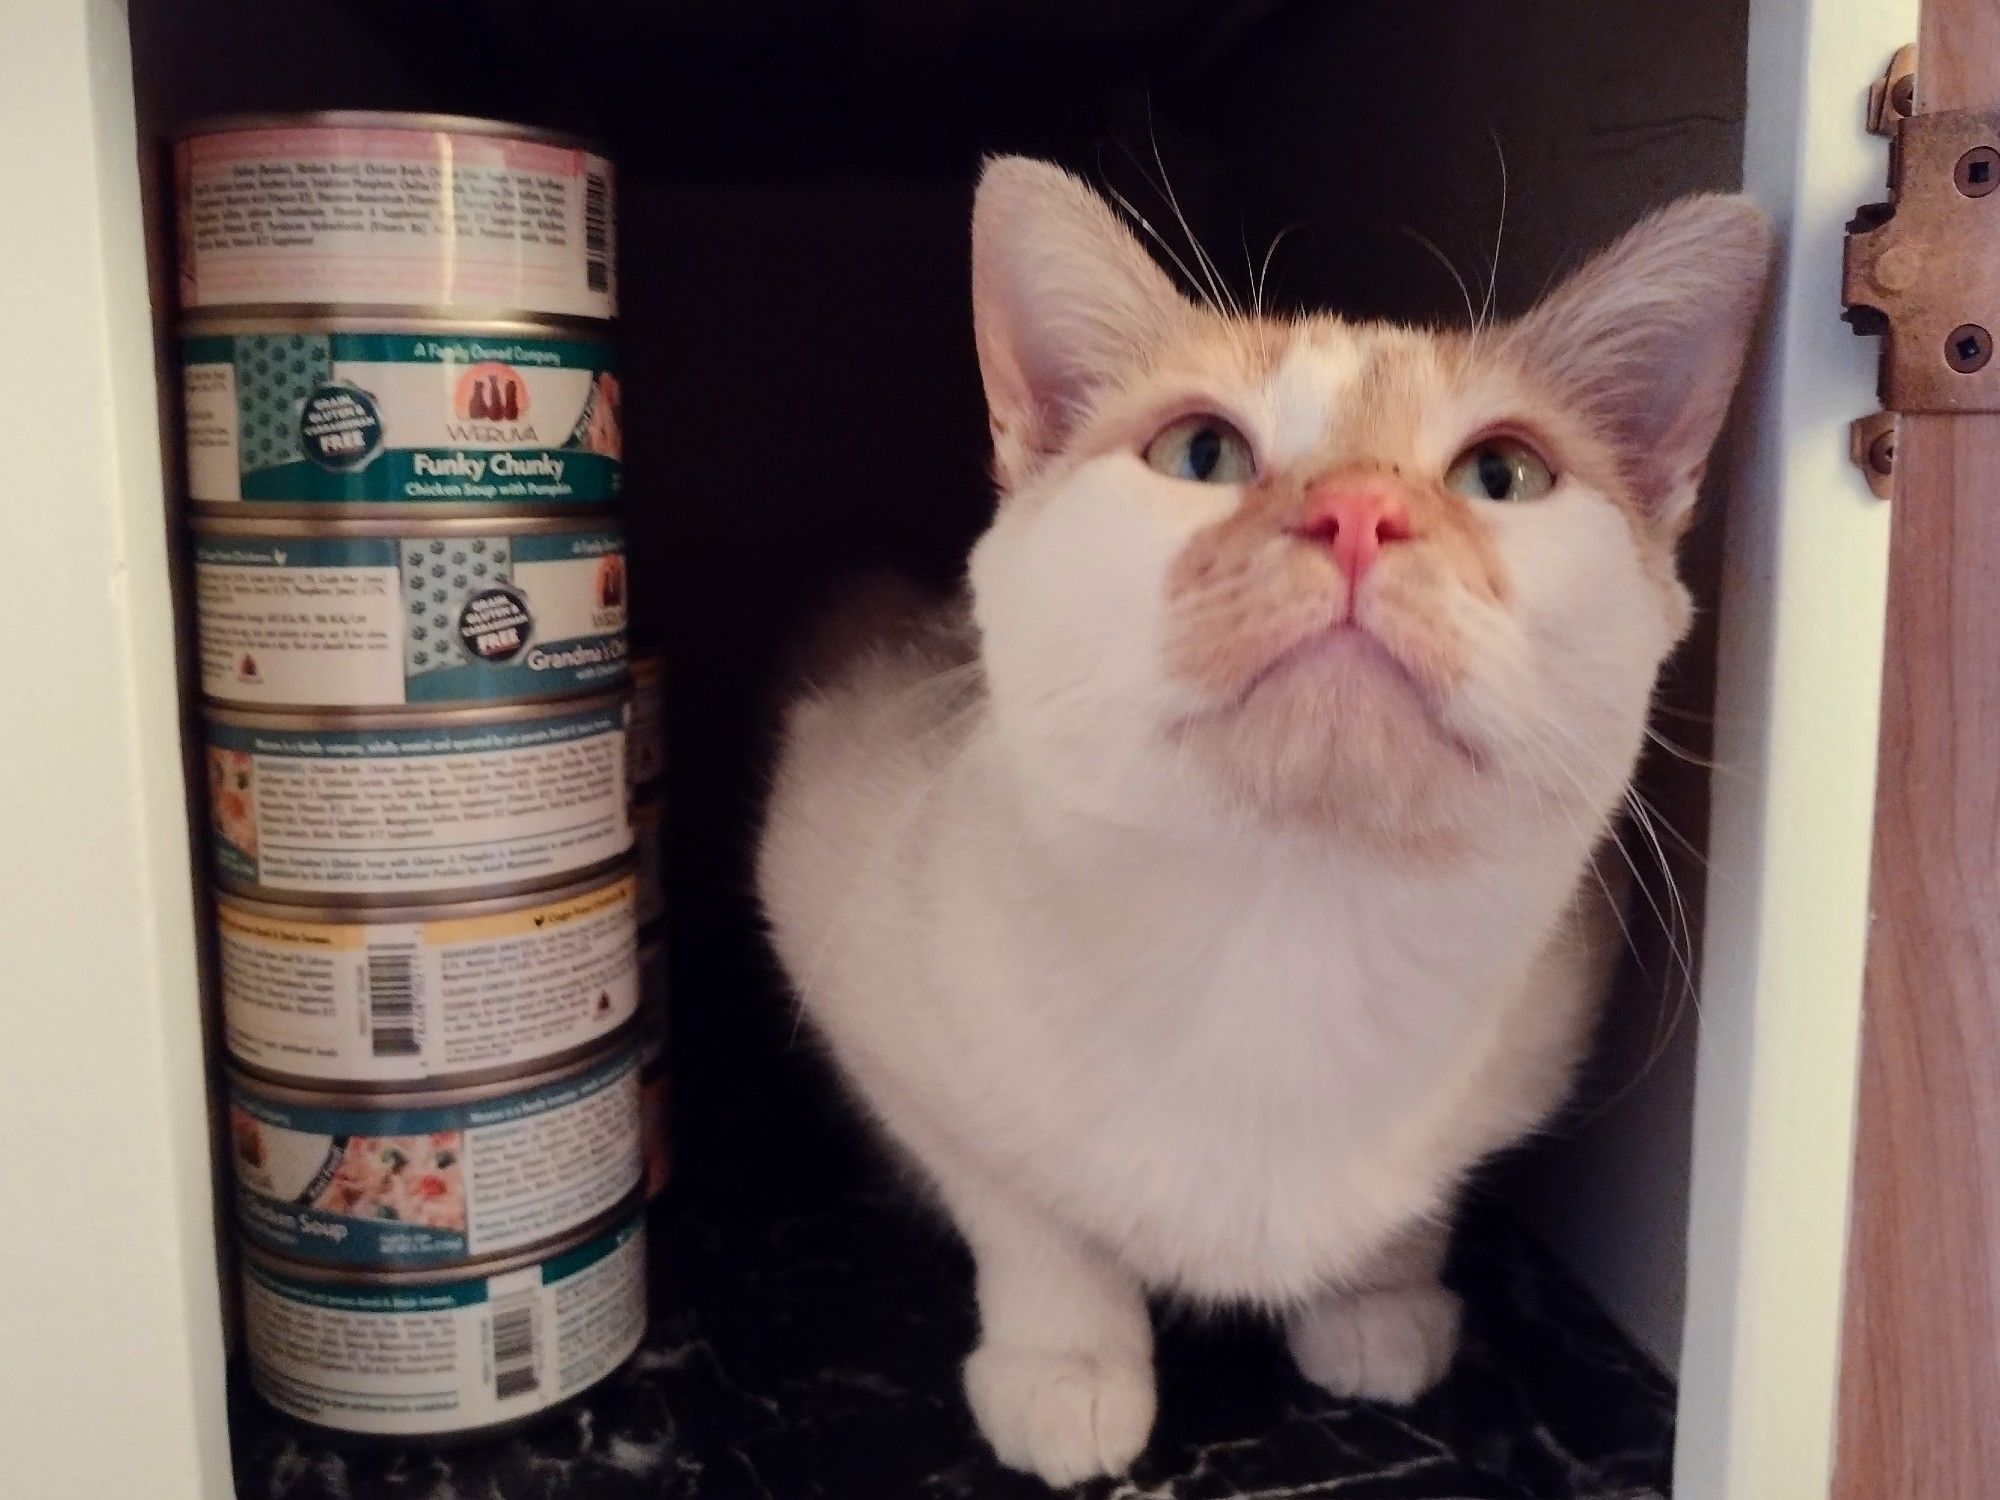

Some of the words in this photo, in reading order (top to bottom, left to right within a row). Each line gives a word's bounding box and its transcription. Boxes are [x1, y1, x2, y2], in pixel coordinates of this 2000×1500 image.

[319, 429, 366, 454] FREE
[446, 424, 540, 442] WERUVA
[414, 452, 486, 482] Funky
[489, 452, 565, 482] Chunky
[405, 481, 462, 497] Chicken
[463, 482, 498, 498] Soup
[499, 482, 528, 496] with
[476, 627, 521, 656] FREE
